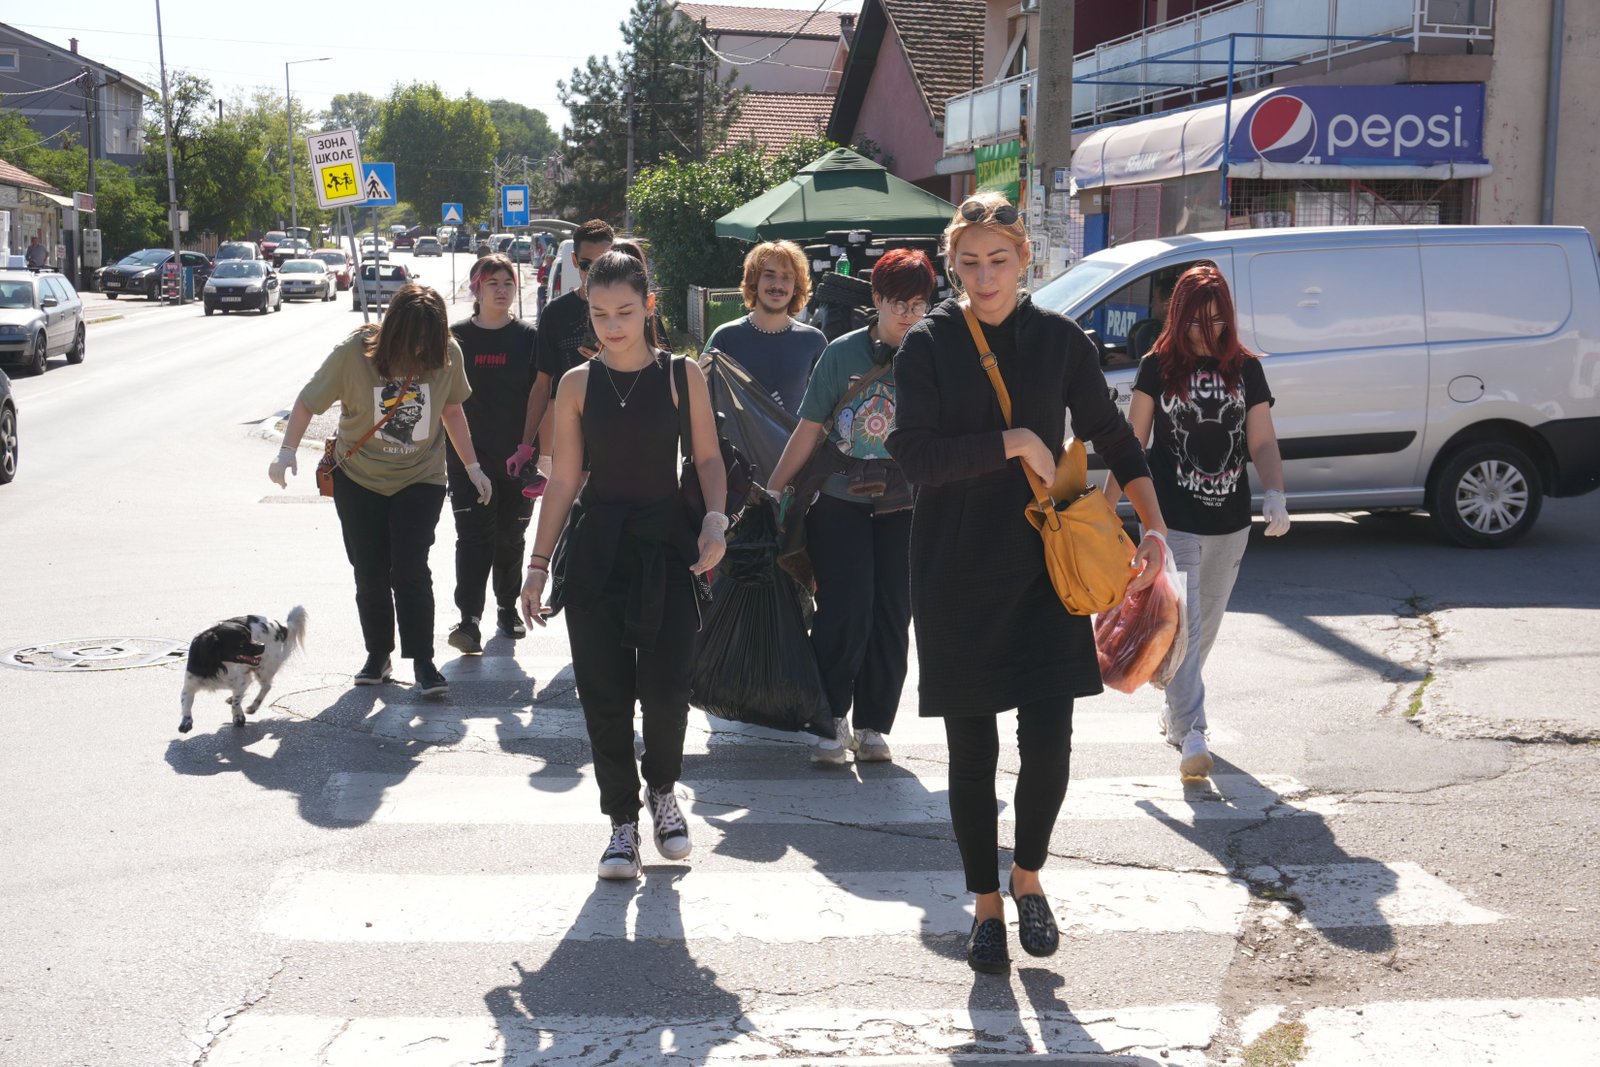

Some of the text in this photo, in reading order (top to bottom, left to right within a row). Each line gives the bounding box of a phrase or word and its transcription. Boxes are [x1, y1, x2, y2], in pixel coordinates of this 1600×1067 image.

[317, 136, 347, 150] ЗОНА
[1327, 105, 1463, 157] pepsi
[314, 148, 355, 165] ШКОЛЕ
[977, 156, 1020, 186] PEKARA
[1176, 463, 1243, 496] MICKEY
